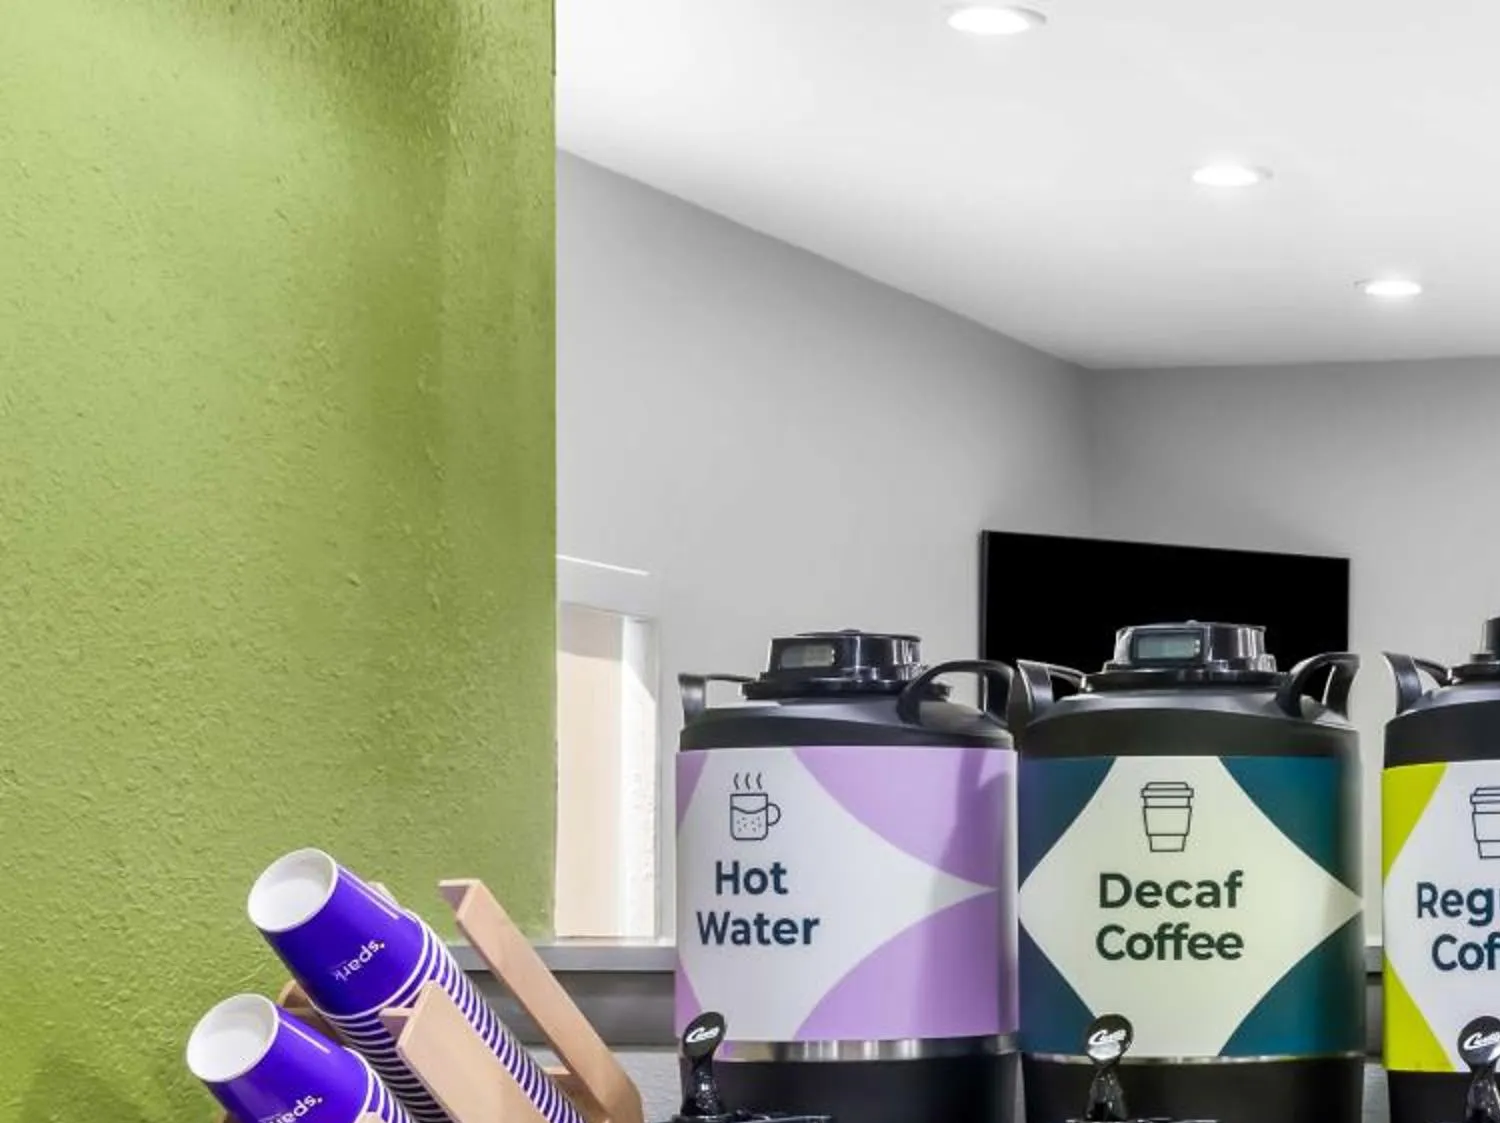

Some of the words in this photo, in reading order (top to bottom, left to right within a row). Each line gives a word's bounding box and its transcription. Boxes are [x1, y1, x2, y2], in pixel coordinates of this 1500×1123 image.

[715, 861, 788, 895] Hot
[1099, 870, 1244, 909] Decaf
[696, 911, 820, 946] Water
[1096, 922, 1244, 960] Coffee
